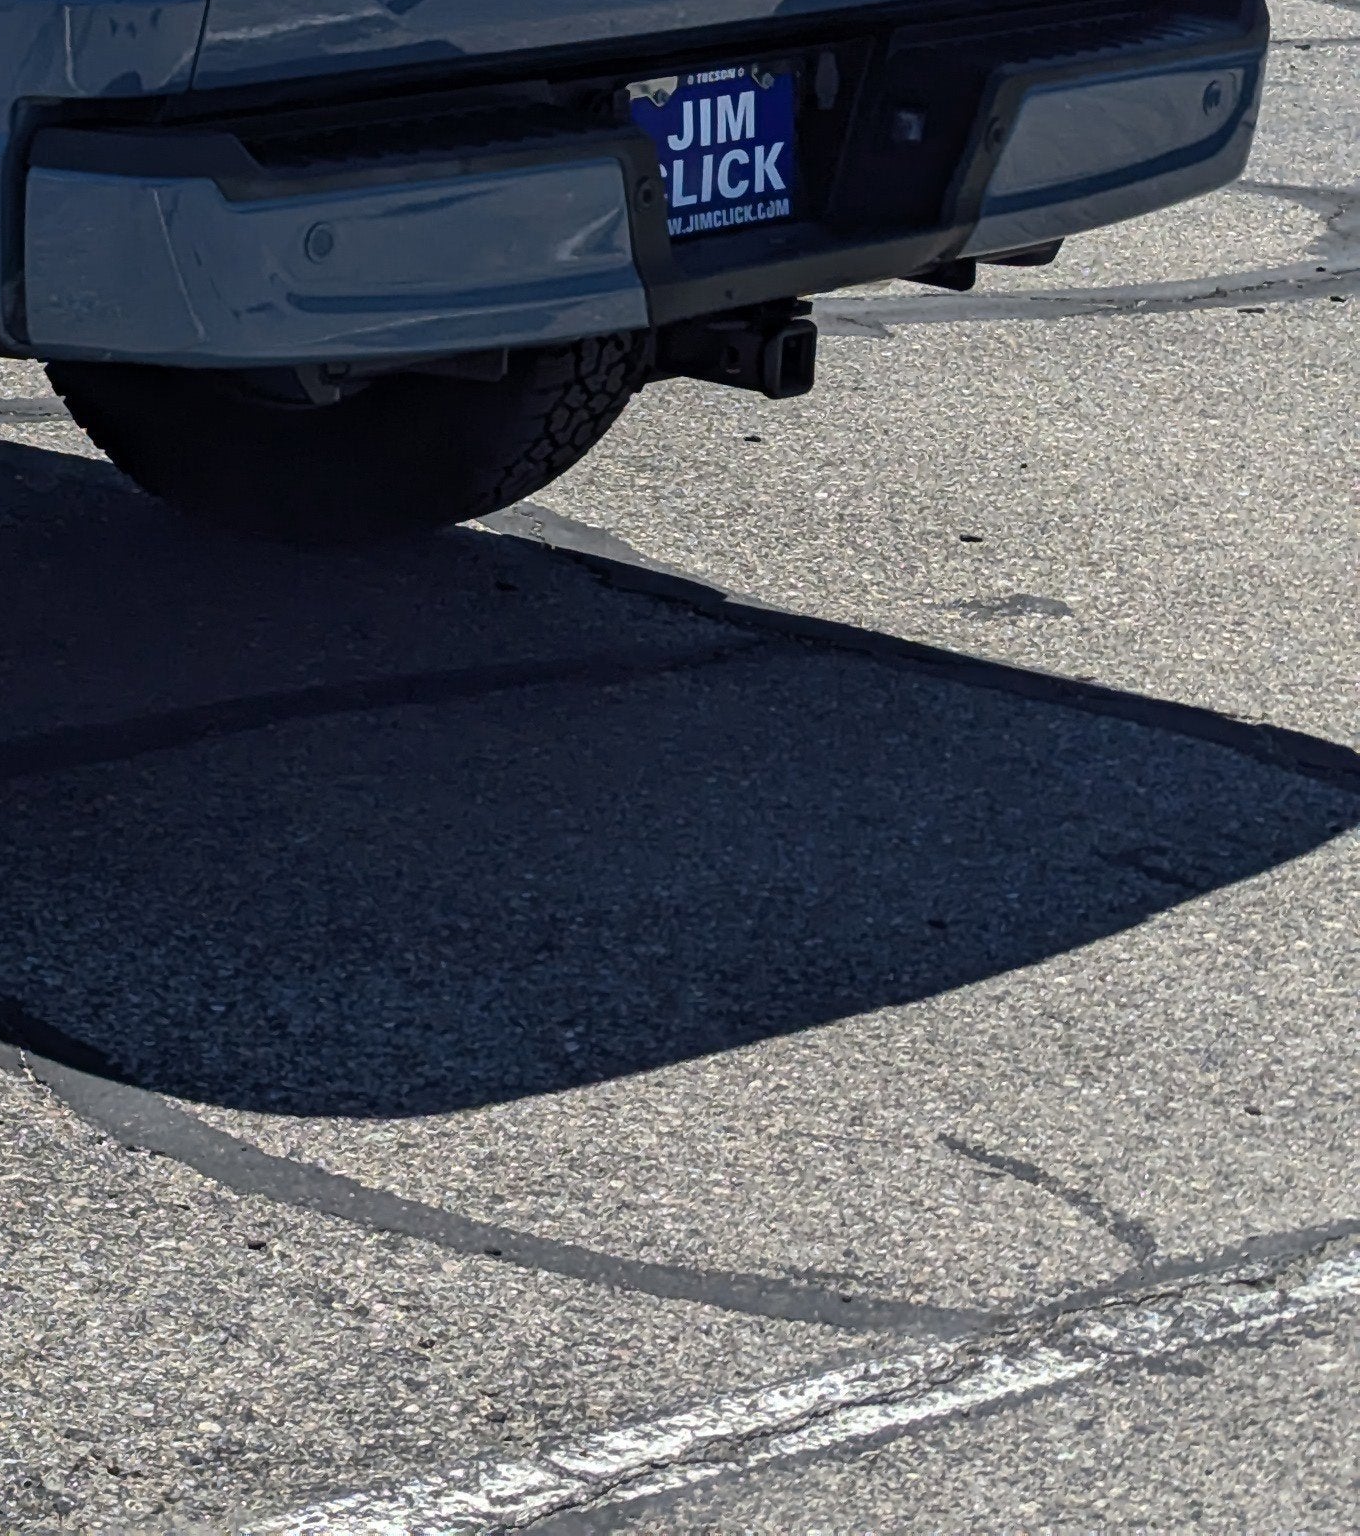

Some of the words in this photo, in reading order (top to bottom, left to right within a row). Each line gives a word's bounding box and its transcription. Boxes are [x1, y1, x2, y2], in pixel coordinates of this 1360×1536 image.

[696, 68, 737, 84] TUCSON
[667, 91, 755, 151] JIM
[660, 142, 787, 207] LICK
